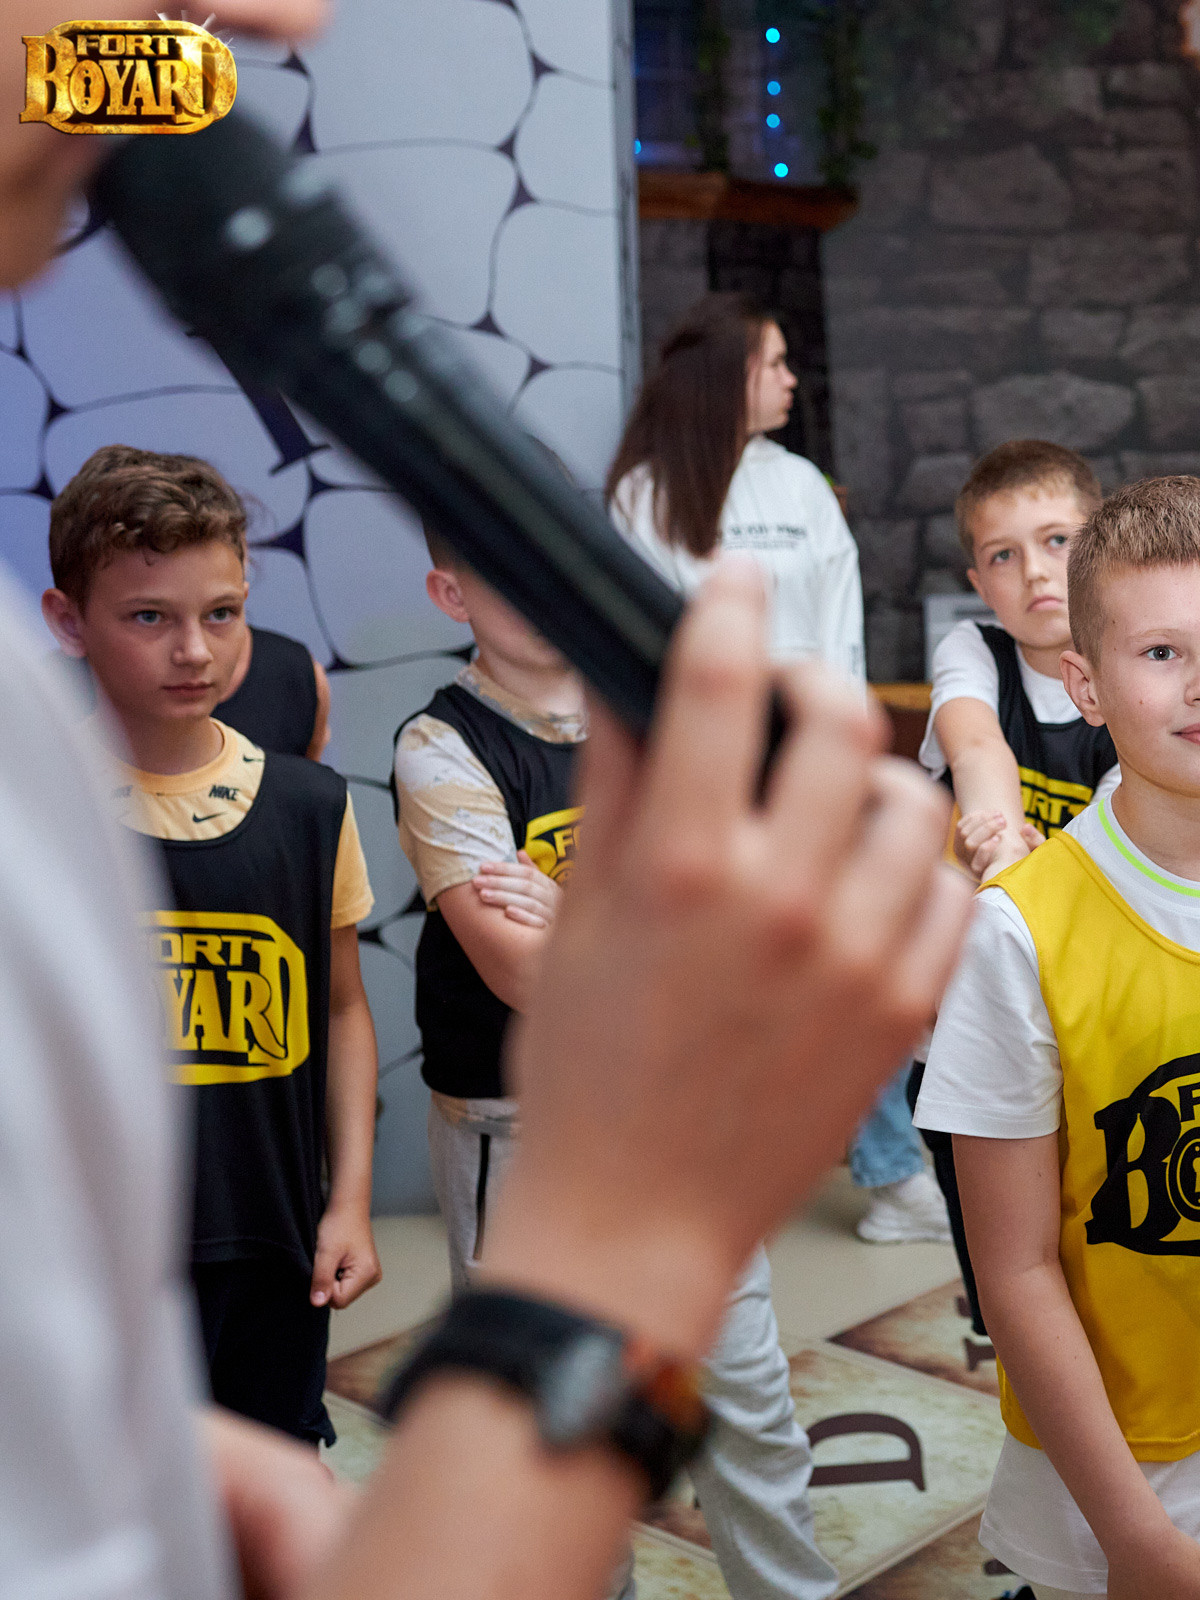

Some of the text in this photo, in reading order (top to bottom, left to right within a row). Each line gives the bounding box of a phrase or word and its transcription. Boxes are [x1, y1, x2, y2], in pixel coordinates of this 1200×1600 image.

[208, 784, 240, 801] NIKE
[154, 932, 252, 966] ORT
[160, 938, 311, 1070] YARD
